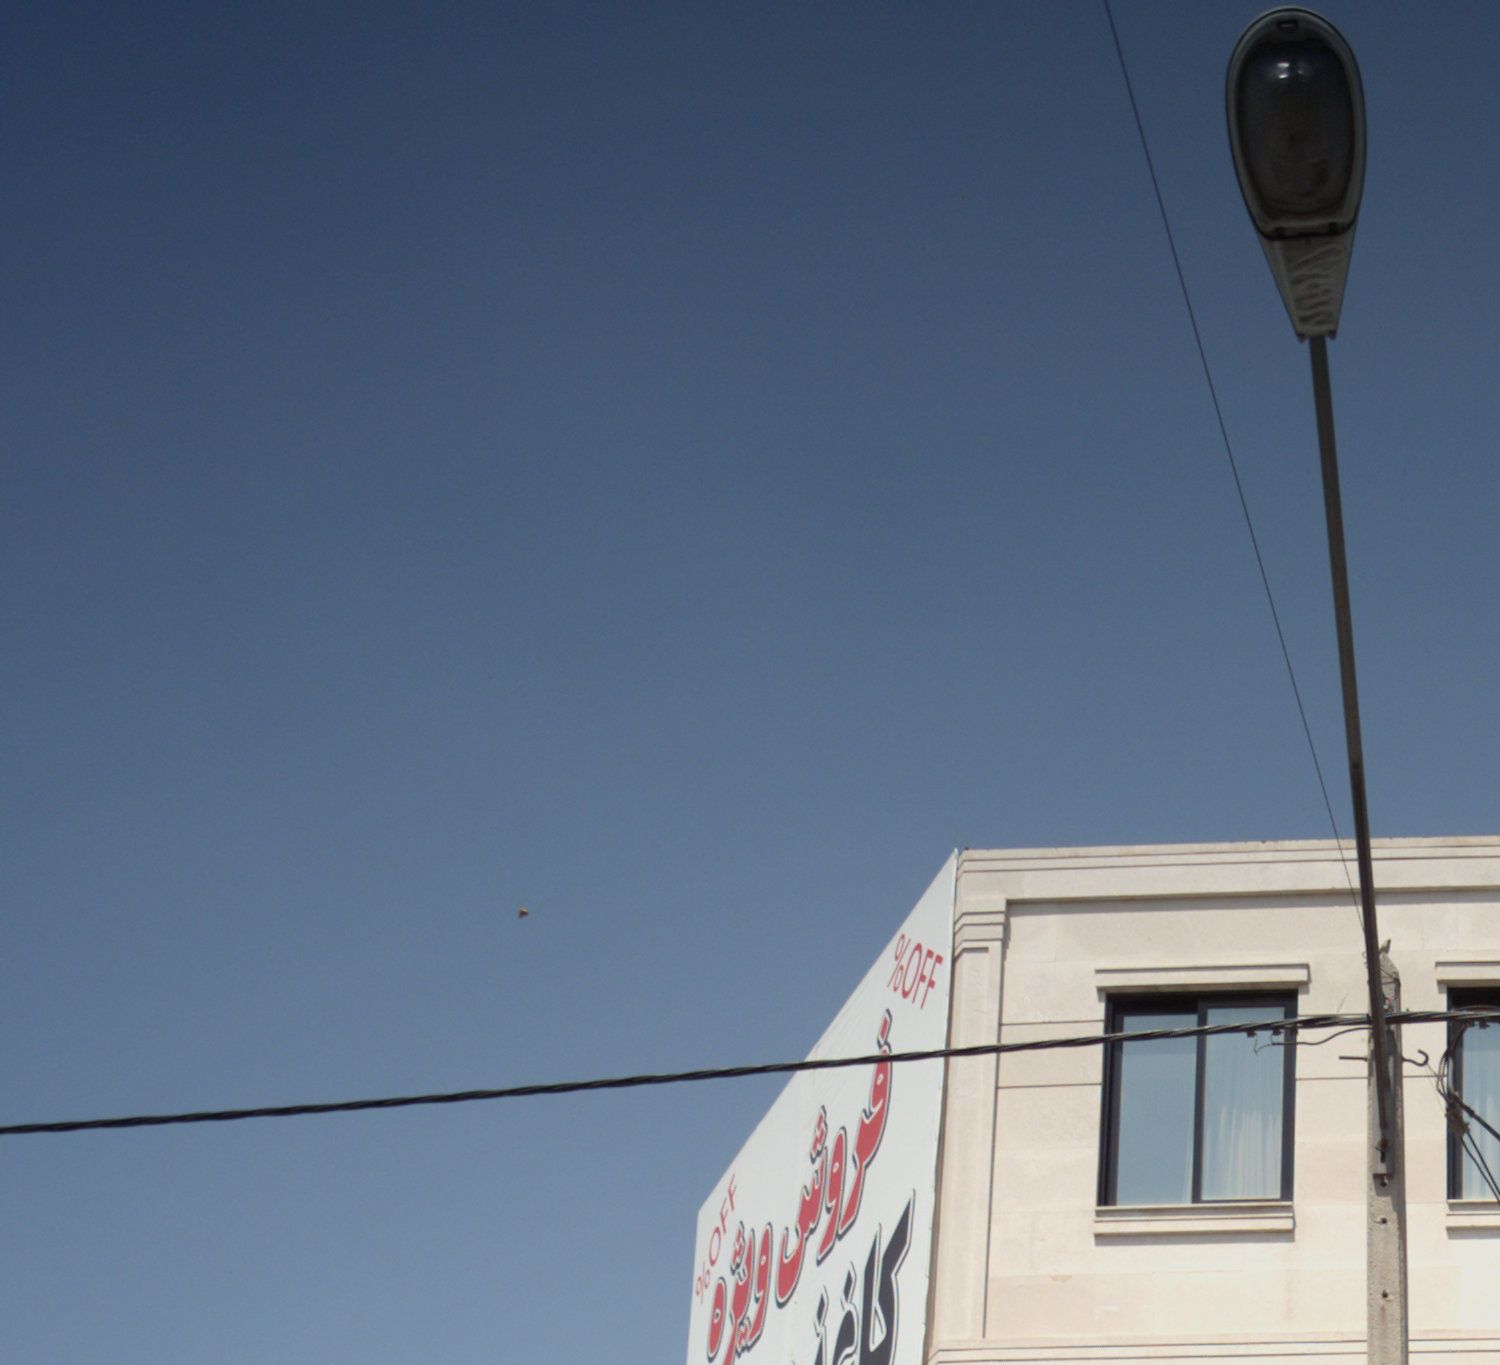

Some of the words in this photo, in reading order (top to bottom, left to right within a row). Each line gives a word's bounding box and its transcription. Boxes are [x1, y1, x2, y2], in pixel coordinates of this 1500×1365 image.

[893, 932, 944, 1011] %OFF
[775, 1009, 893, 1308] فروش
[695, 1172, 740, 1302] %OFF
